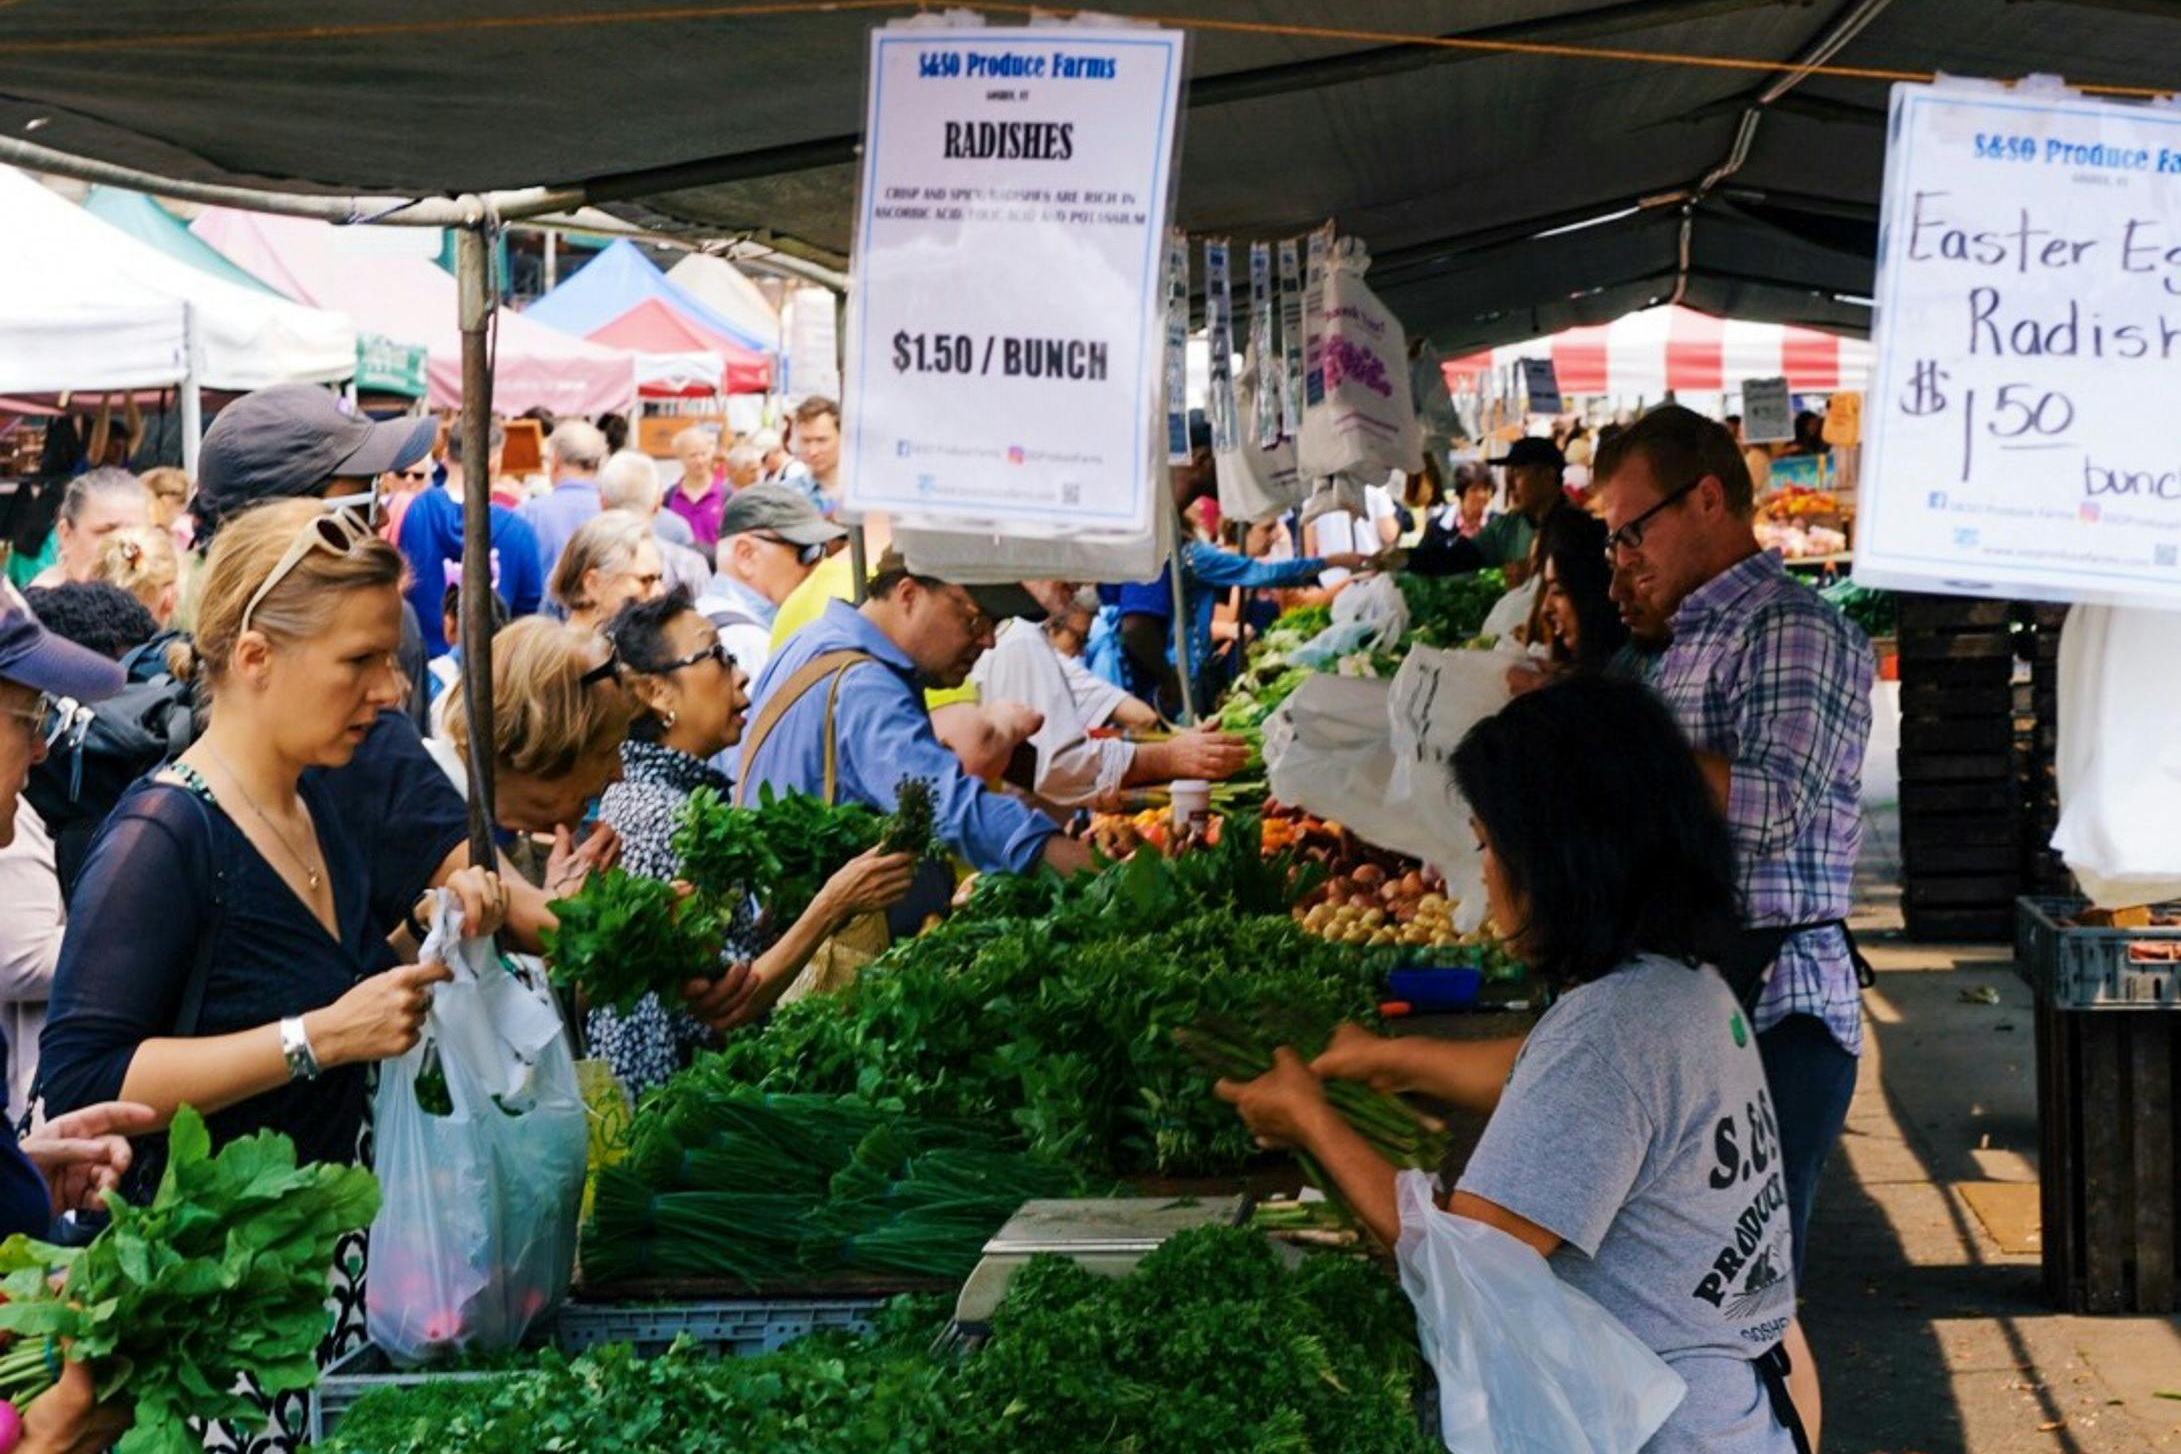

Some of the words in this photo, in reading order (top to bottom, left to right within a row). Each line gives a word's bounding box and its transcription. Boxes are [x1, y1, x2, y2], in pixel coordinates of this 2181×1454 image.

[967, 53, 1045, 78] Produce
[1052, 53, 1116, 79] Farms
[944, 121, 1074, 160] RADISHES
[2045, 138, 2149, 170] Produce
[1056, 190, 1078, 203] ARE
[1083, 191, 1117, 204] RICH
[1908, 190, 2099, 273] Easter
[893, 329, 973, 374] $1.50
[981, 336, 995, 375] /
[1003, 337, 1108, 381] BUNCH
